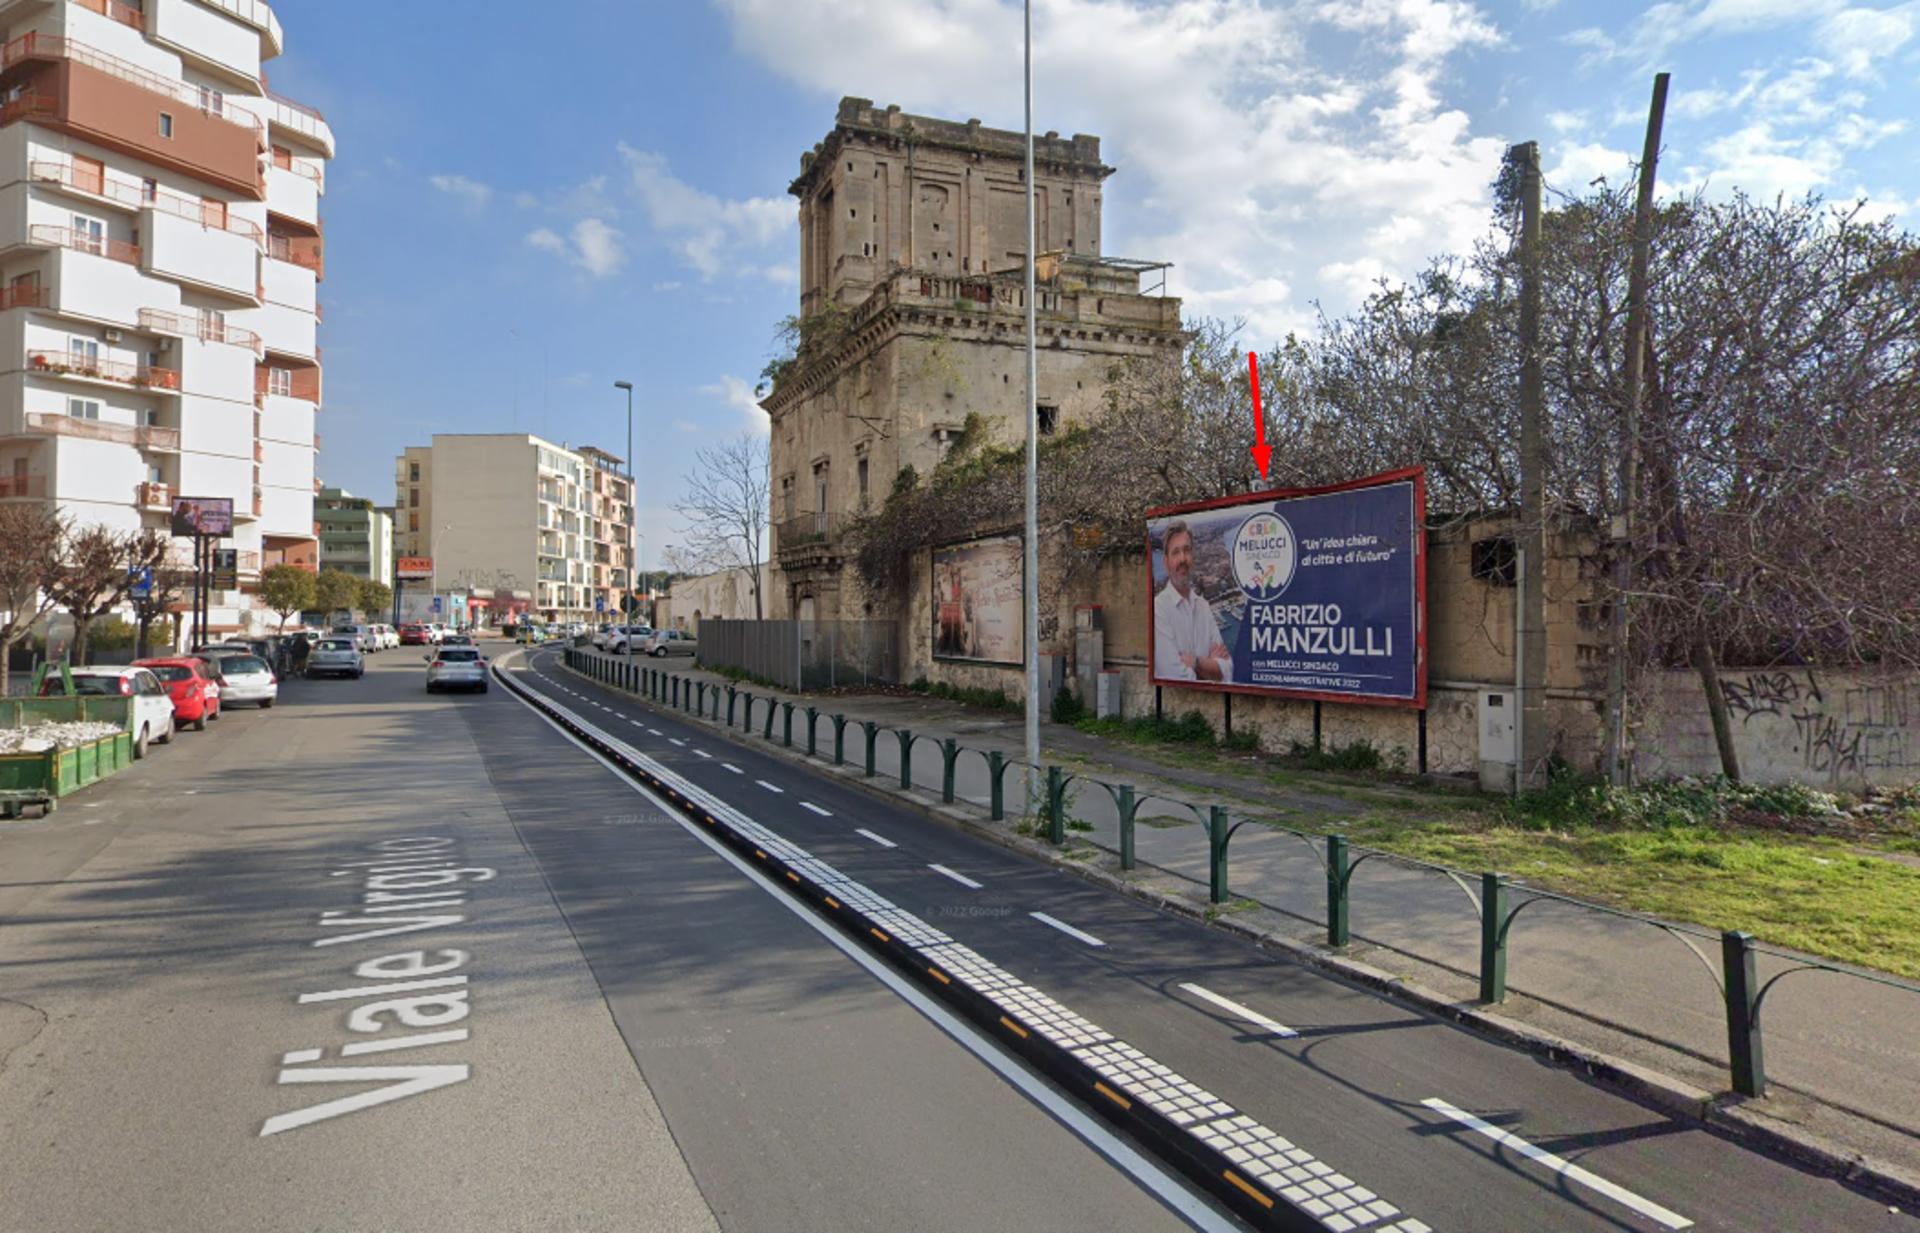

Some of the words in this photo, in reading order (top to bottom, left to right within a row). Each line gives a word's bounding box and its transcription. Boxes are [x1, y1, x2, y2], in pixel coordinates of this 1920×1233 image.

[1248, 521, 1277, 537] CREA
[1239, 537, 1287, 552] MELUCCI
[1346, 534, 1378, 547] chiara
[1301, 554, 1312, 567] di
[1312, 552, 1335, 566] città
[1336, 556, 1343, 565] e
[1344, 551, 1355, 563] di
[1251, 603, 1342, 626] FABRIZIO
[1251, 626, 1392, 657] MANZULLI
[1252, 660, 1266, 669] con
[1266, 659, 1301, 670] MELUCCI
[1302, 661, 1340, 672] SINDACO
